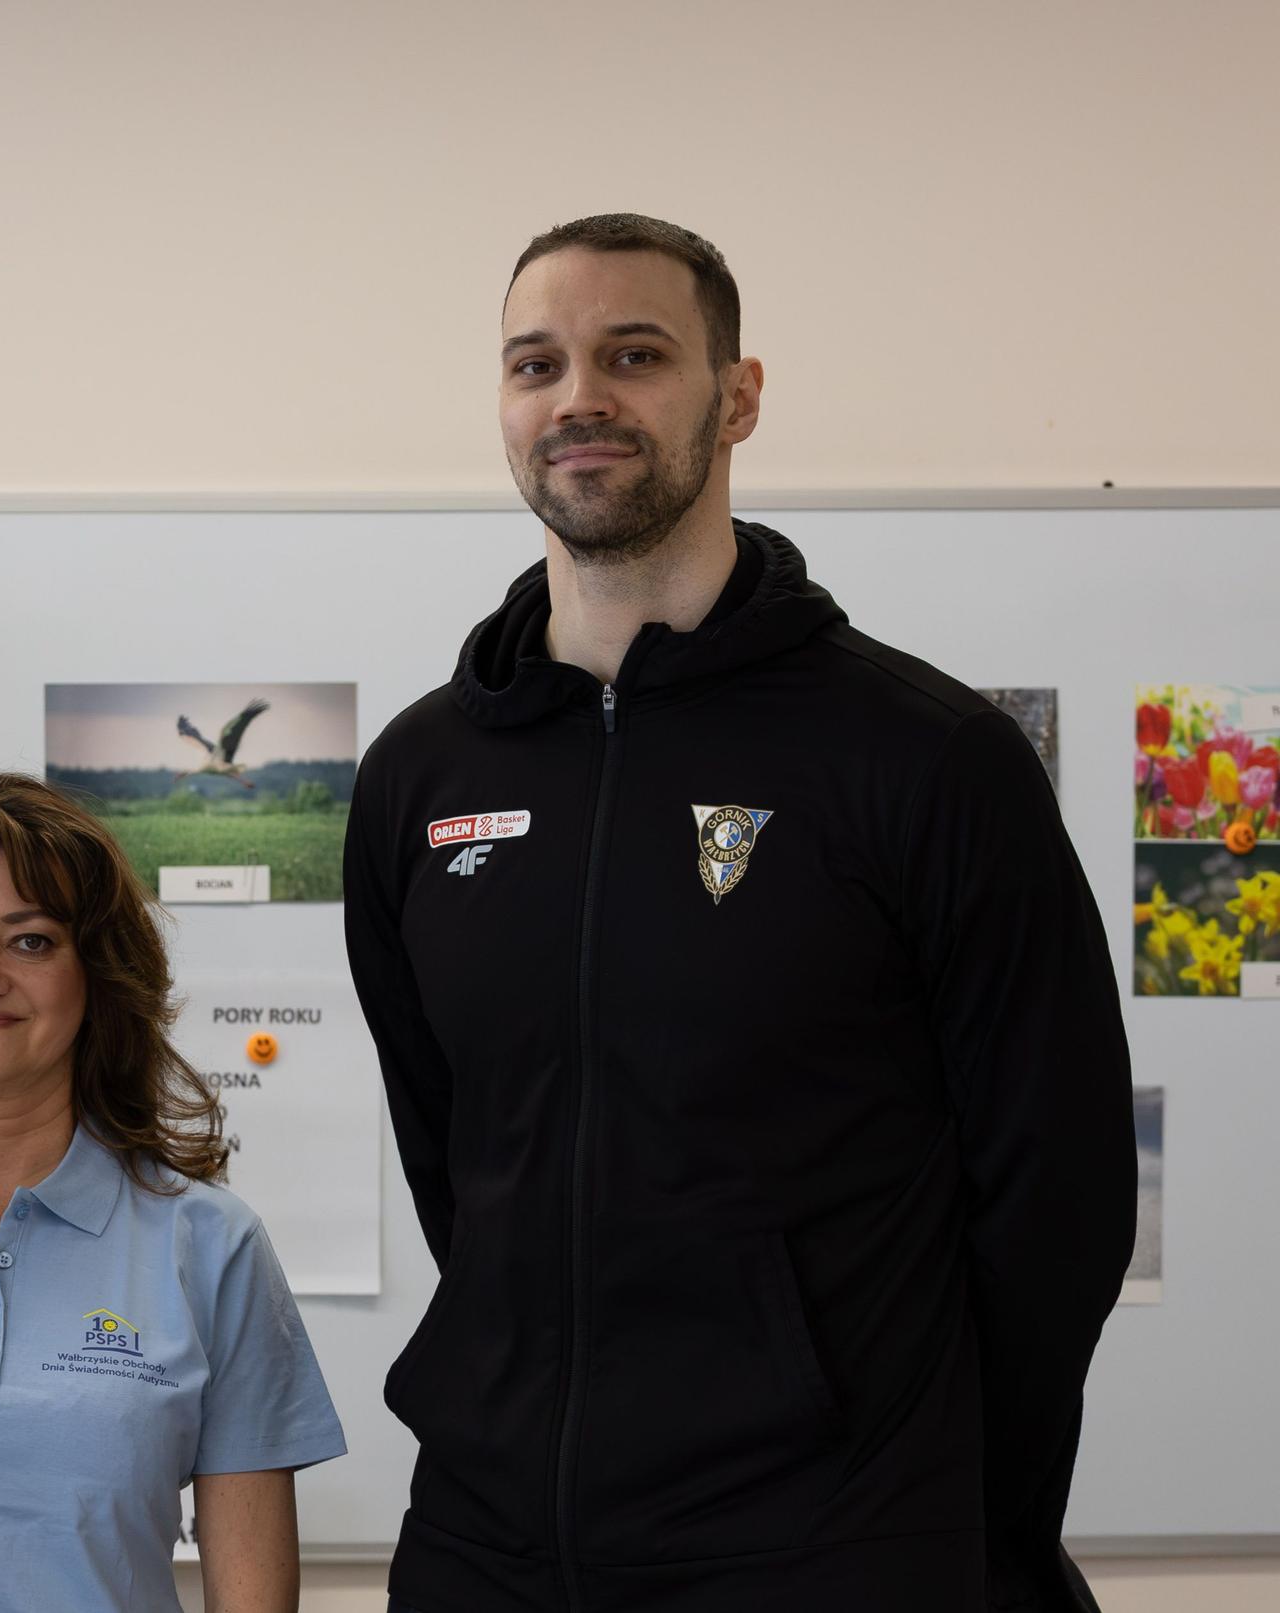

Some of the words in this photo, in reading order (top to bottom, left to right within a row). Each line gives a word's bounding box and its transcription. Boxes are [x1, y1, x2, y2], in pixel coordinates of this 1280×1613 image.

[497, 815, 525, 825] Basket
[433, 821, 472, 841] ORLEN
[496, 825, 514, 836] Liga
[447, 844, 493, 876] 4F
[213, 1007, 263, 1024] PORY
[269, 1008, 321, 1024] ROKU
[85, 1331, 127, 1347] PSPS
[57, 1352, 119, 1366] Wałbrzyskie
[122, 1358, 167, 1376] Obchody
[42, 1362, 65, 1372] Dnia
[68, 1362, 135, 1379] Świadomości
[137, 1372, 179, 1389] Autyzmu
